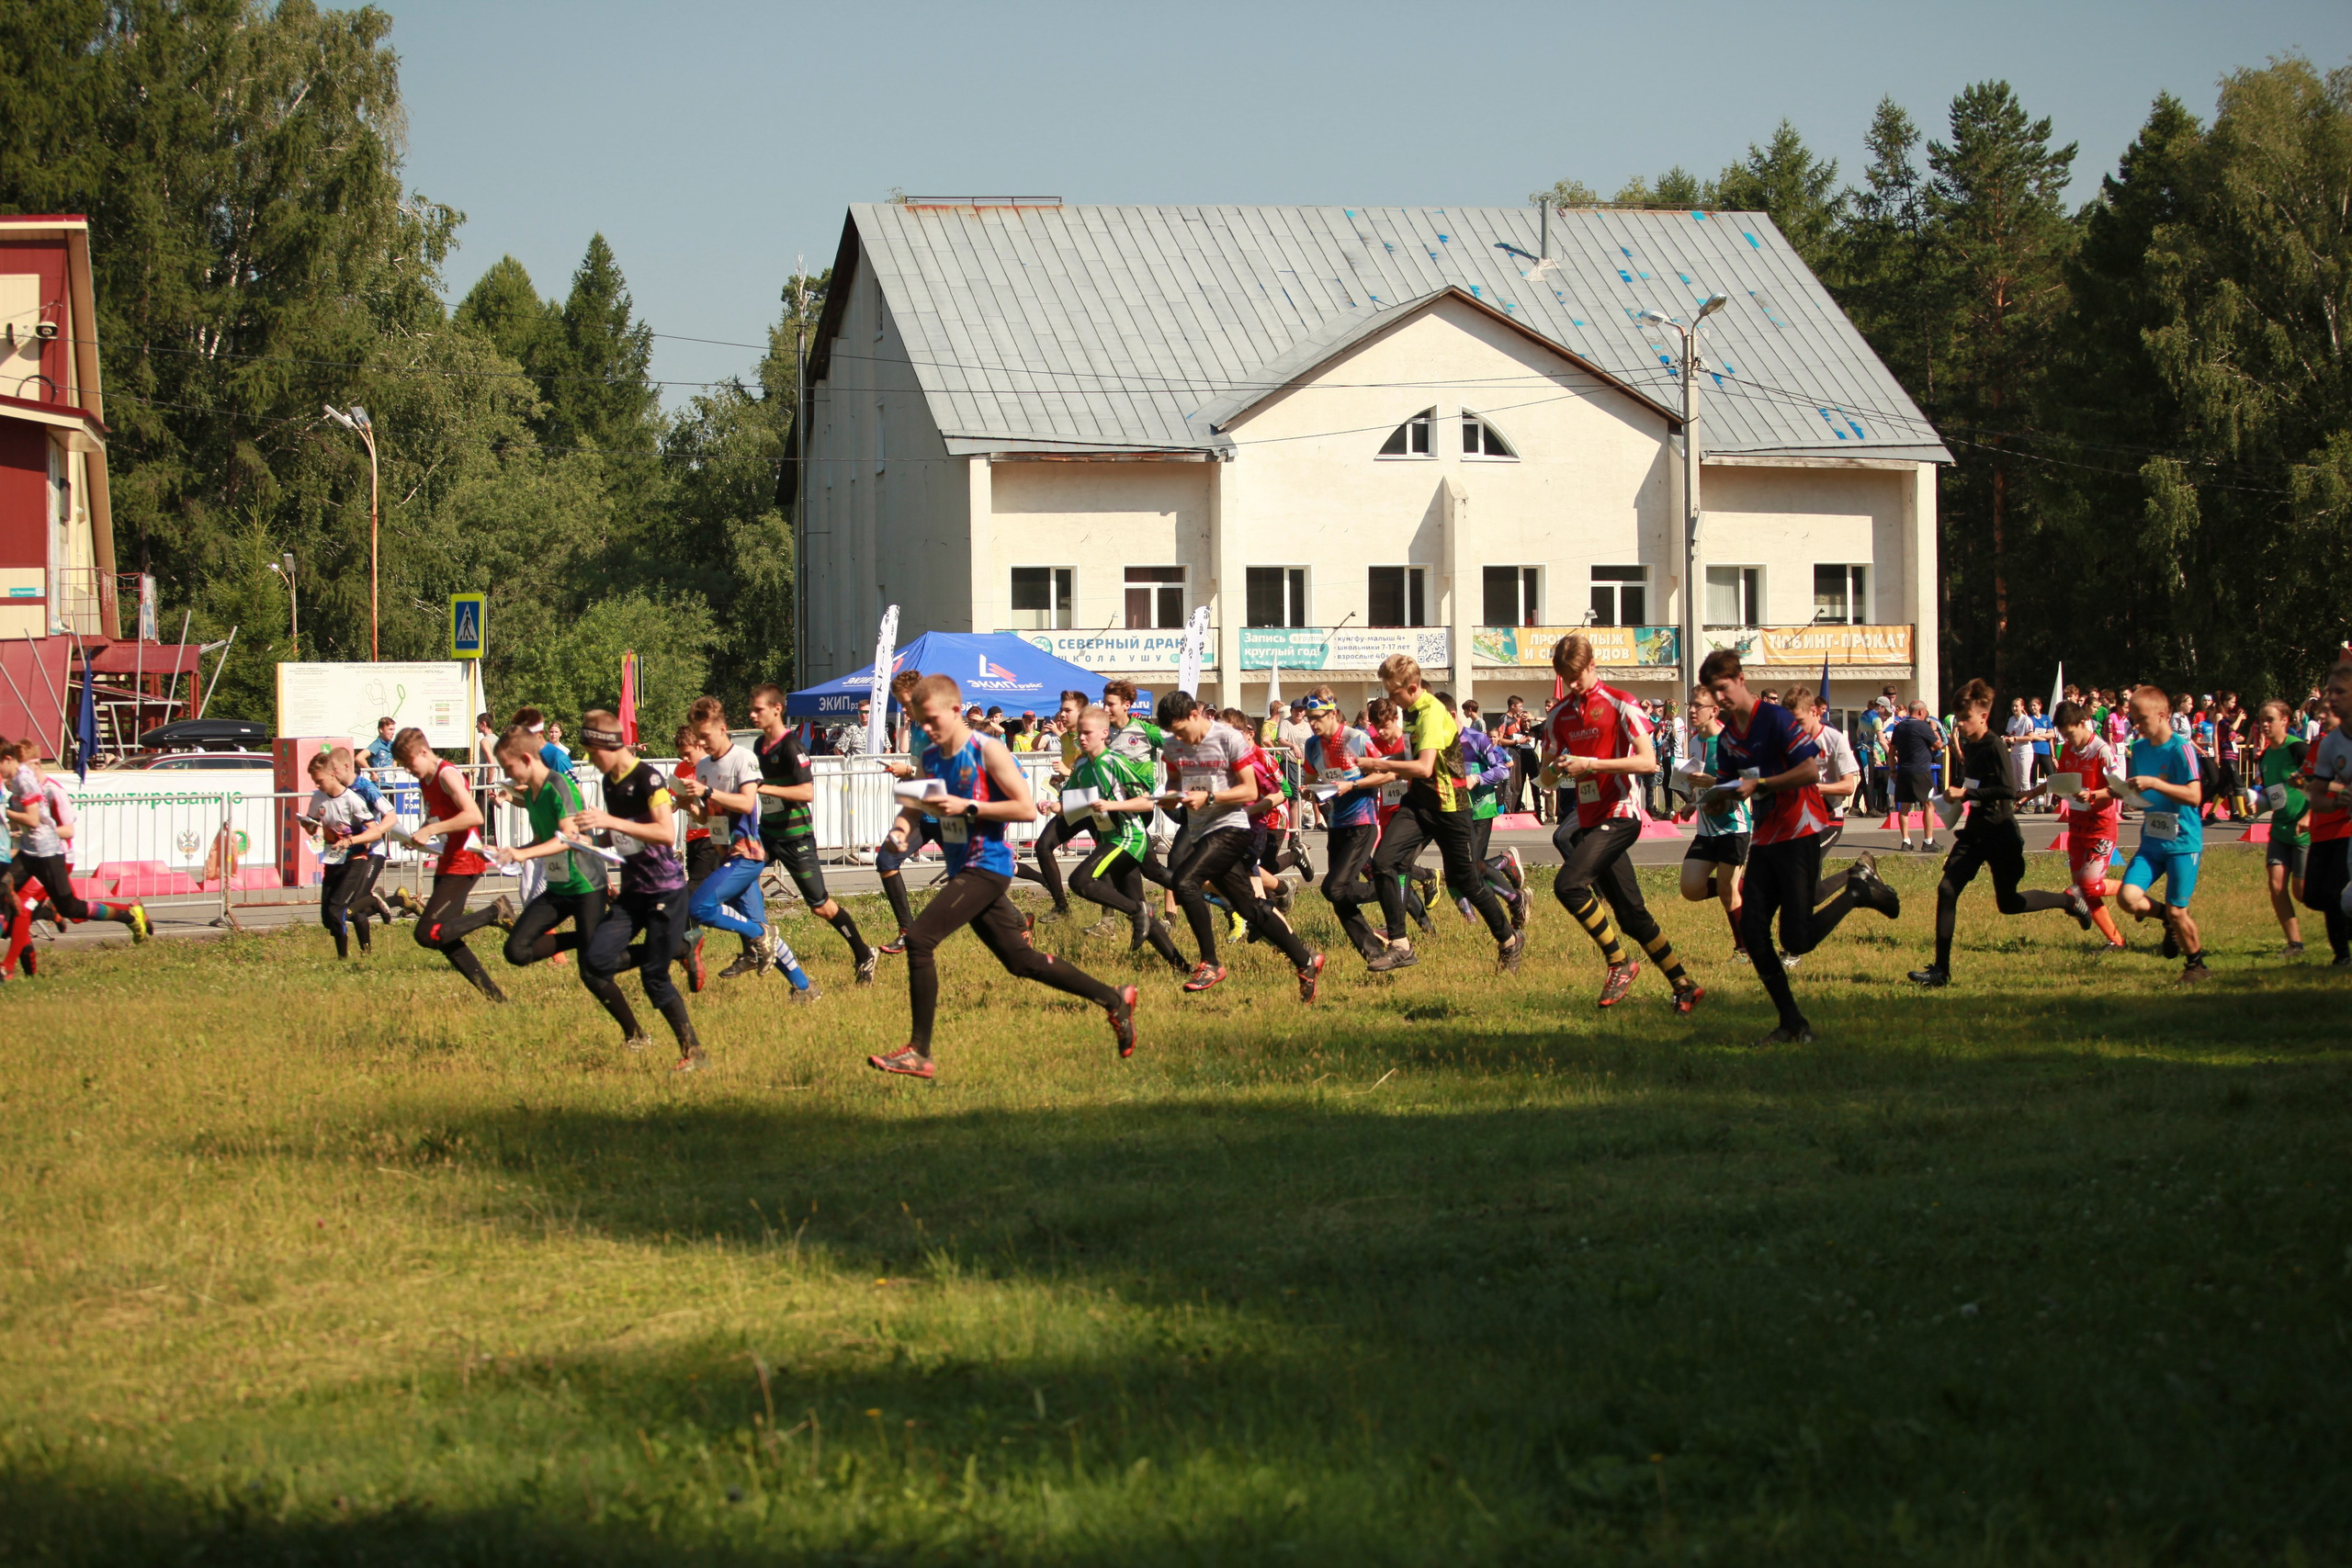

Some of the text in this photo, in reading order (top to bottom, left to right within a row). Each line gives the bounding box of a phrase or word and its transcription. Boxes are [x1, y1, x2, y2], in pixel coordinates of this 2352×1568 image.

[1058, 636, 1184, 651] СЕВЕРНЫЙ ДРАК
[1244, 633, 1286, 643] Запись
[1768, 633, 1905, 649] ТЮБИНГ-ПРОКАТ
[1129, 654, 1161, 662] УШУ
[1244, 646, 1320, 659] круглый год!
[1524, 649, 1534, 660] И
[1568, 728, 1599, 739] SUUNTO
